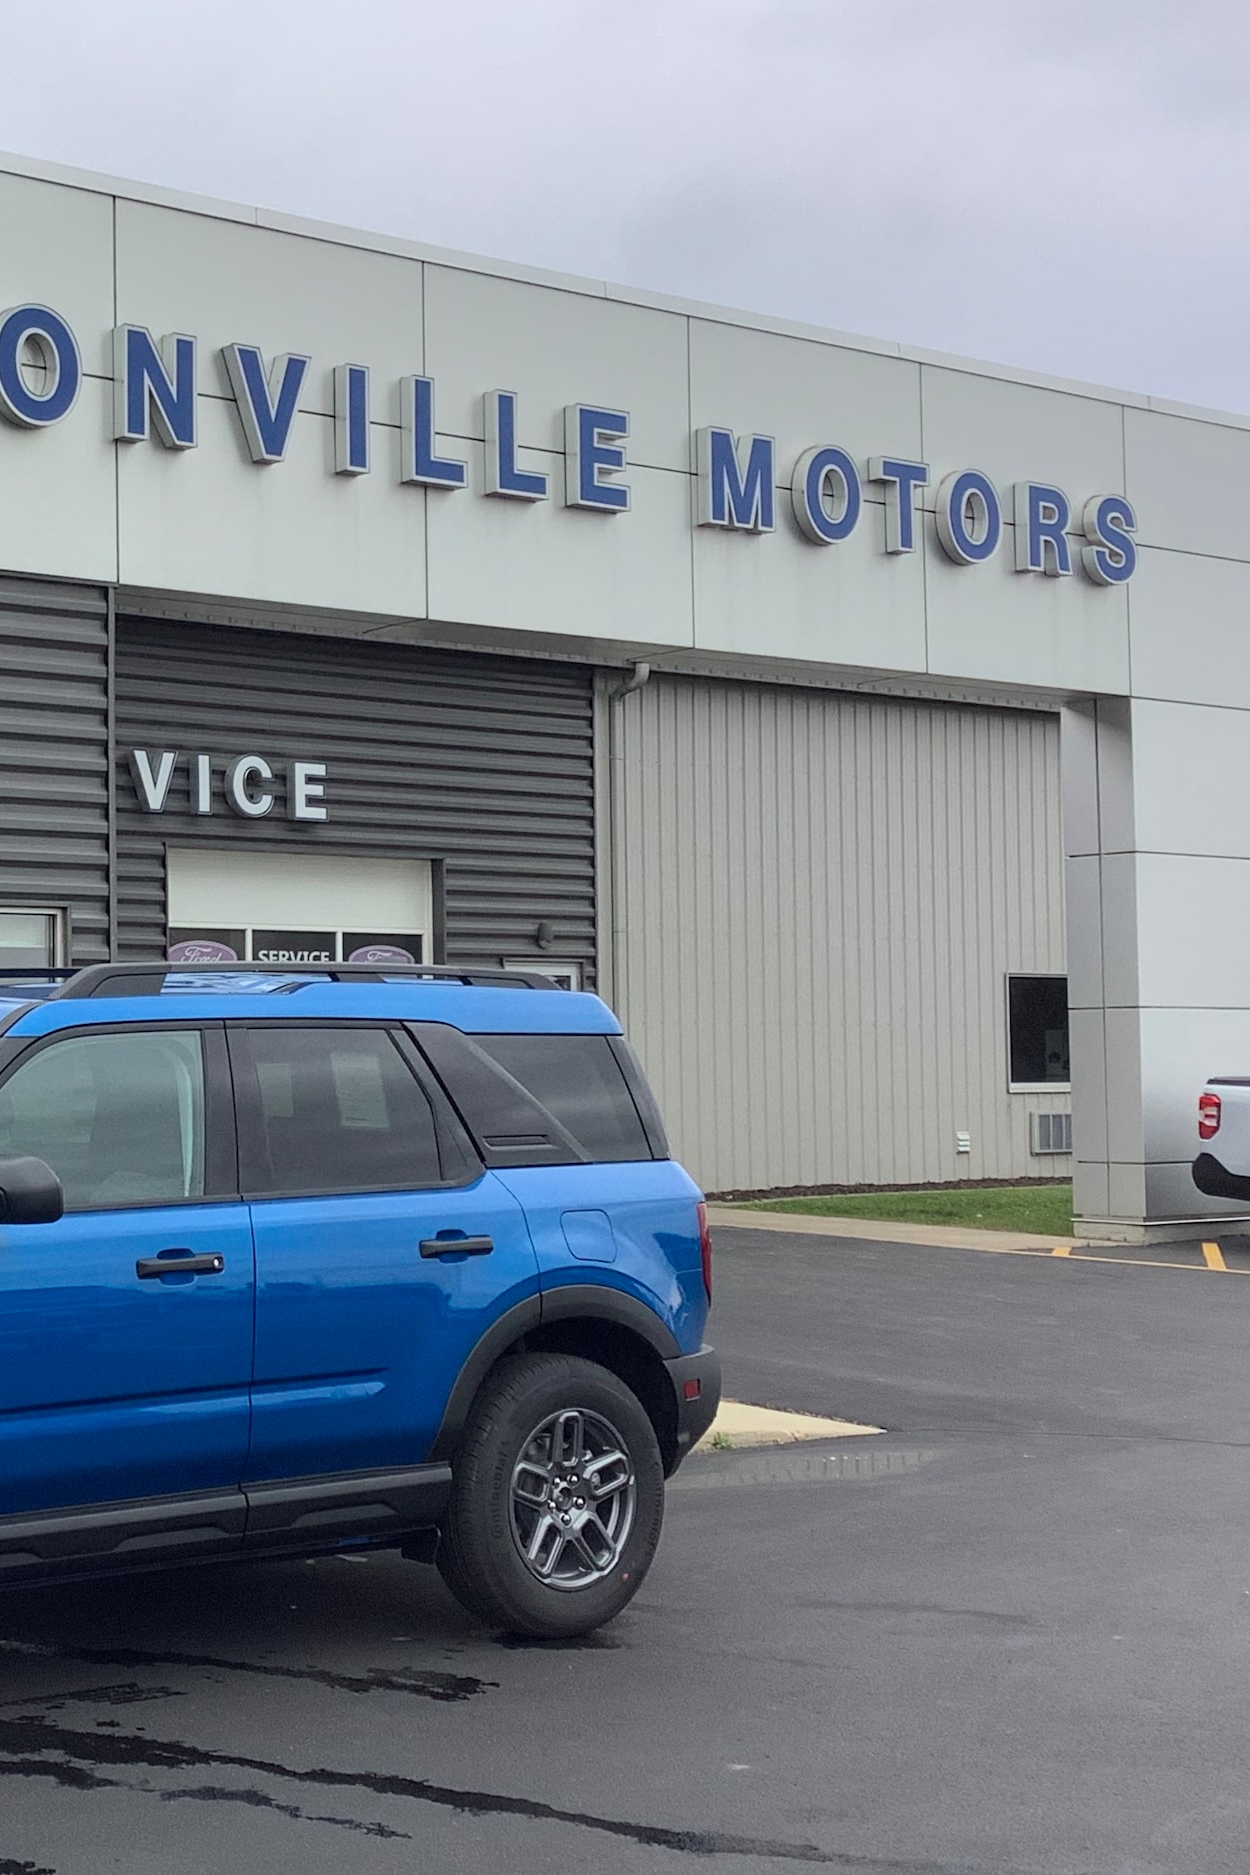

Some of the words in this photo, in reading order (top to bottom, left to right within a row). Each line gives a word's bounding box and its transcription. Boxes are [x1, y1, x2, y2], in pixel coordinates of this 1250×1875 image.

[696, 425, 1138, 586] MOTORS
[130, 748, 329, 822] VICE
[258, 949, 330, 962] SERVICE
